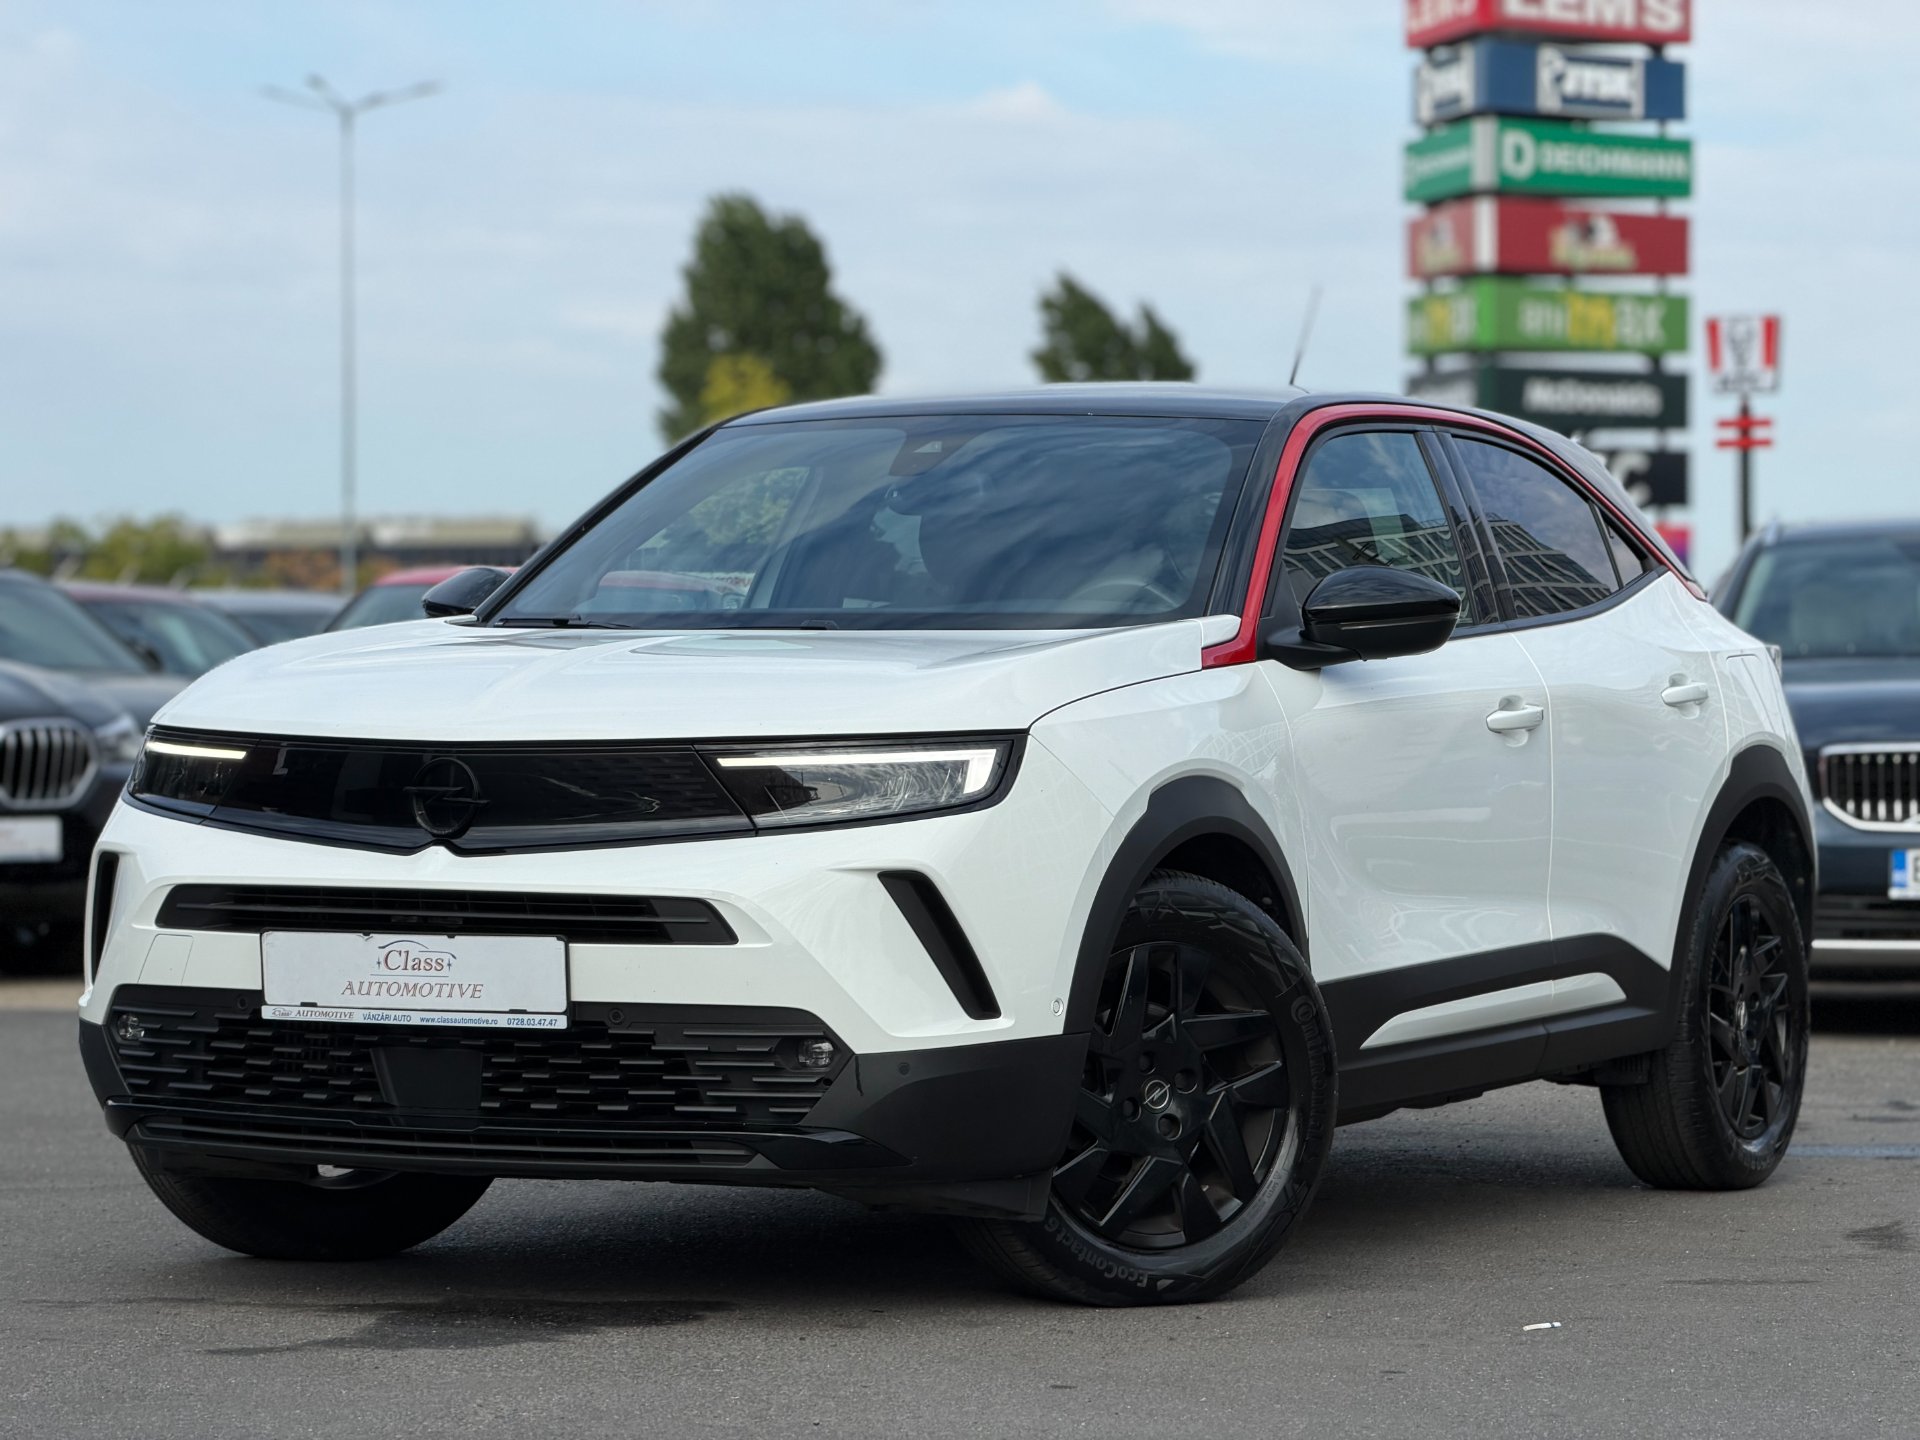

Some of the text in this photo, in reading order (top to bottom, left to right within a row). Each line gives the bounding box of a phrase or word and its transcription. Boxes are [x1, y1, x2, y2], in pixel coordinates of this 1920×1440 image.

[384, 949, 445, 972] Class
[341, 981, 484, 999] AUTOMOTIVE
[295, 1010, 354, 1019] AUTOMOTIVE
[393, 1014, 412, 1022] AUTO
[420, 1015, 498, 1025] www.classautomotive.ro
[507, 1018, 558, 1027] 0728.03.47.47
[1044, 1216, 1149, 1288] EcoContact 6
